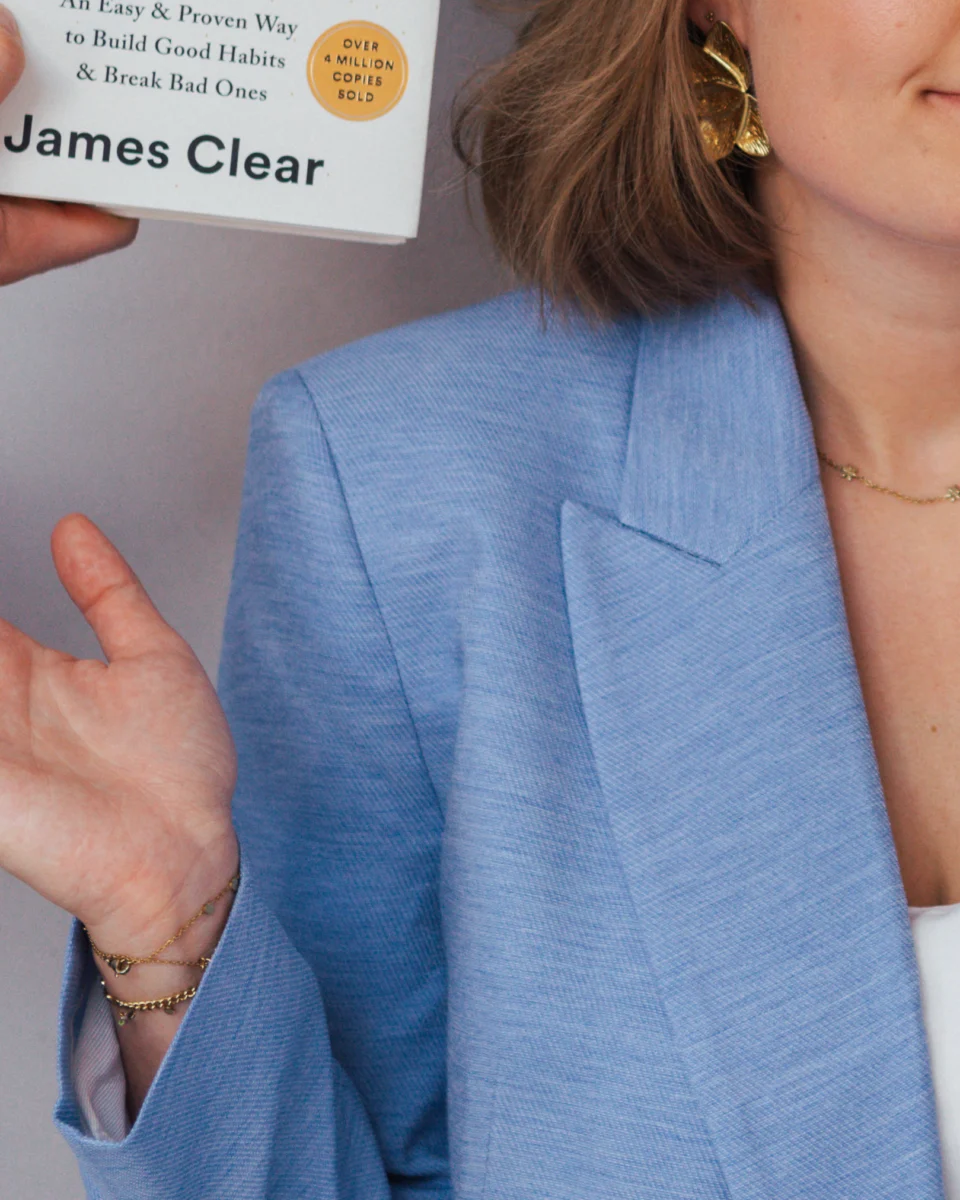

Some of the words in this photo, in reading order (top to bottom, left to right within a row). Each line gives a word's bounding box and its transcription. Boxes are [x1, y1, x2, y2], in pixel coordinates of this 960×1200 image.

[150, 1, 171, 20] &
[178, 5, 248, 29] Proven
[254, 13, 299, 40] Way
[65, 29, 85, 45] to
[92, 29, 148, 53] Build
[154, 37, 212, 61] Good
[217, 43, 287, 70] Habits
[343, 38, 379, 52] OVER
[324, 54, 331, 63] 4
[336, 55, 395, 71] MILLION
[76, 63, 97, 81] &
[103, 65, 162, 89] Break
[169, 74, 208, 95] Bad
[215, 78, 268, 103] Ones
[332, 71, 383, 87] COPIES
[338, 89, 374, 103] SOLD
[3, 113, 170, 169] James
[187, 133, 326, 187] Clear
